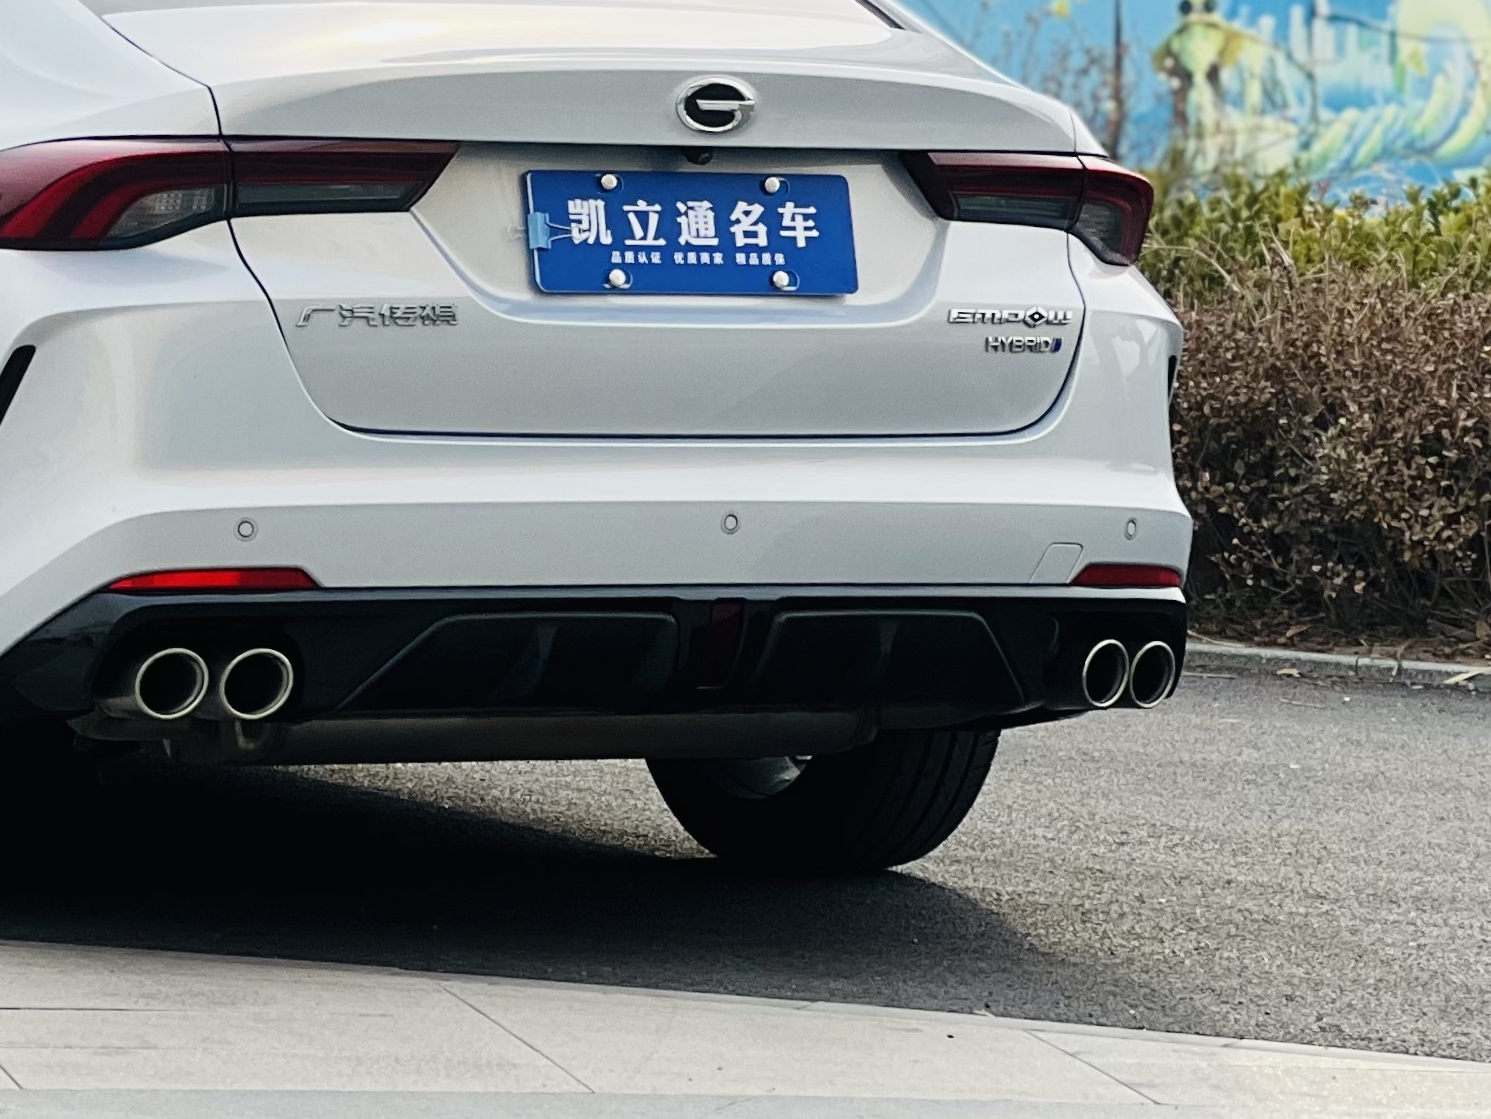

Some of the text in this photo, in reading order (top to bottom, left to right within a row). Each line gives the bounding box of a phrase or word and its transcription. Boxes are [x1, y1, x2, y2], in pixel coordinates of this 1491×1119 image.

[567, 198, 820, 248] 凯立通名车
[295, 303, 458, 328] 广汽传祺
[949, 306, 1073, 328] EMPOW
[985, 336, 1053, 354] HYBRID
